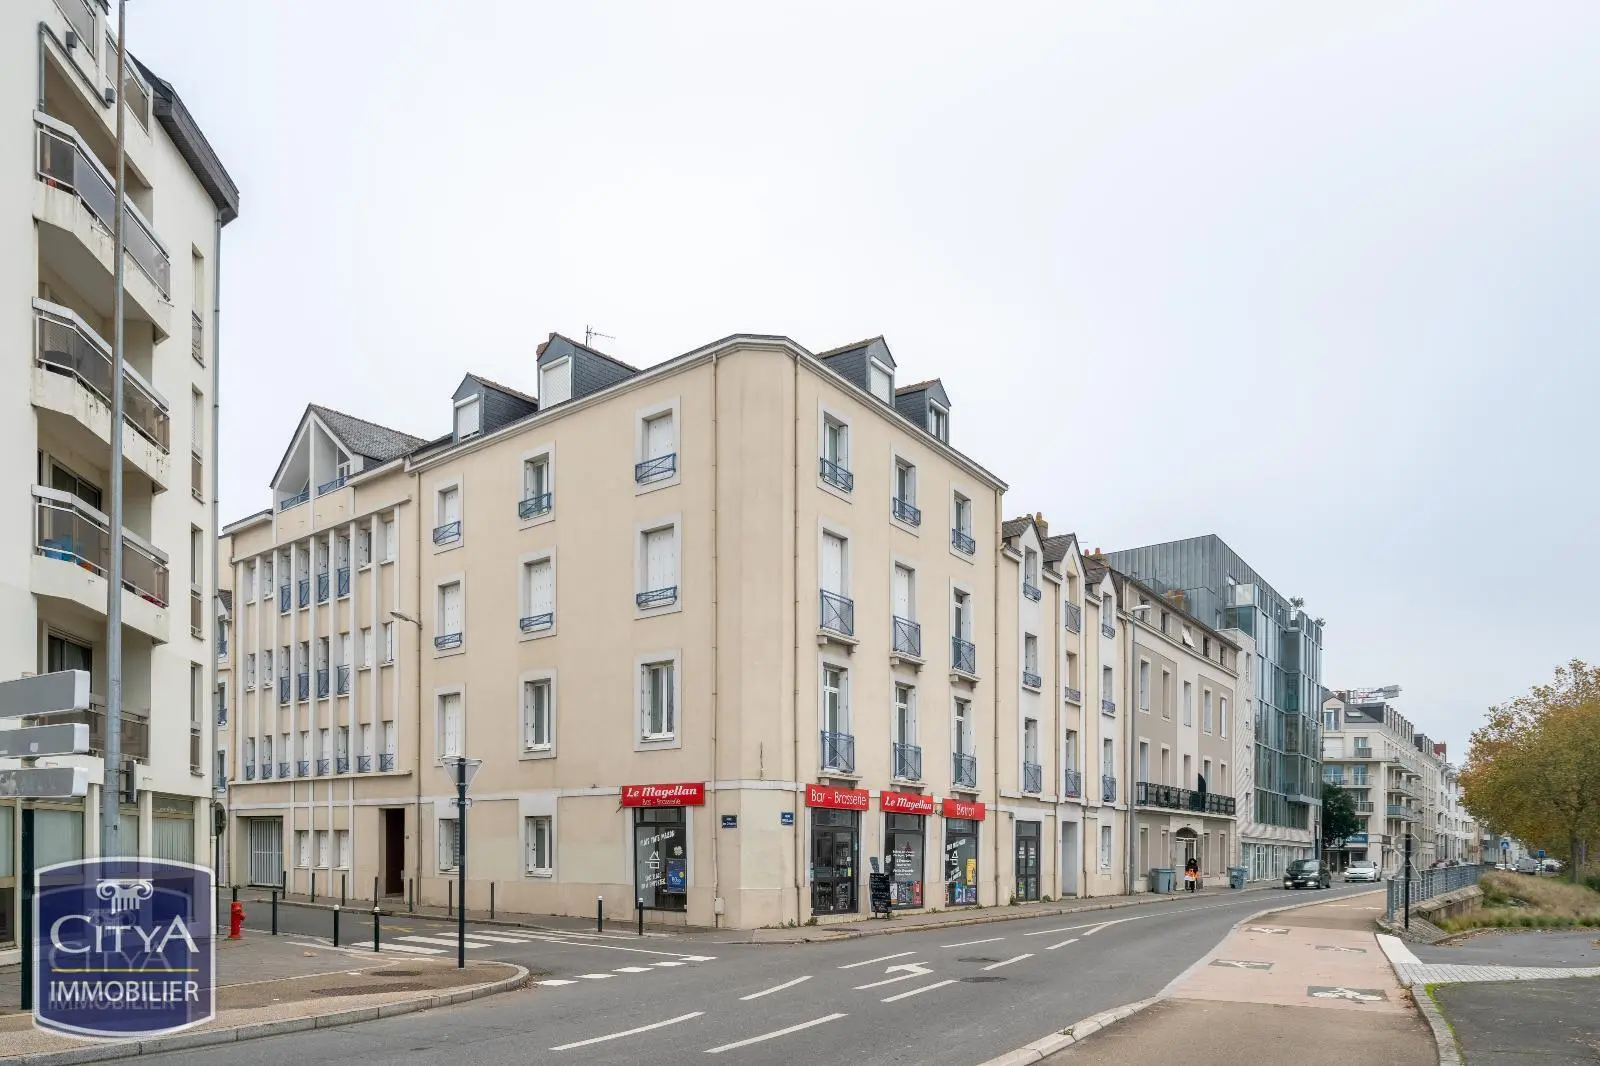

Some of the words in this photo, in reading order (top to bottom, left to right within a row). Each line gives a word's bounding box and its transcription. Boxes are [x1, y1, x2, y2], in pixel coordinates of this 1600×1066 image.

[627, 787, 639, 797] Le
[642, 786, 697, 799] Magellan
[811, 789, 826, 803] Bar
[834, 791, 867, 806] Brasserie
[884, 796, 895, 807] Le
[896, 797, 932, 811] Magellan
